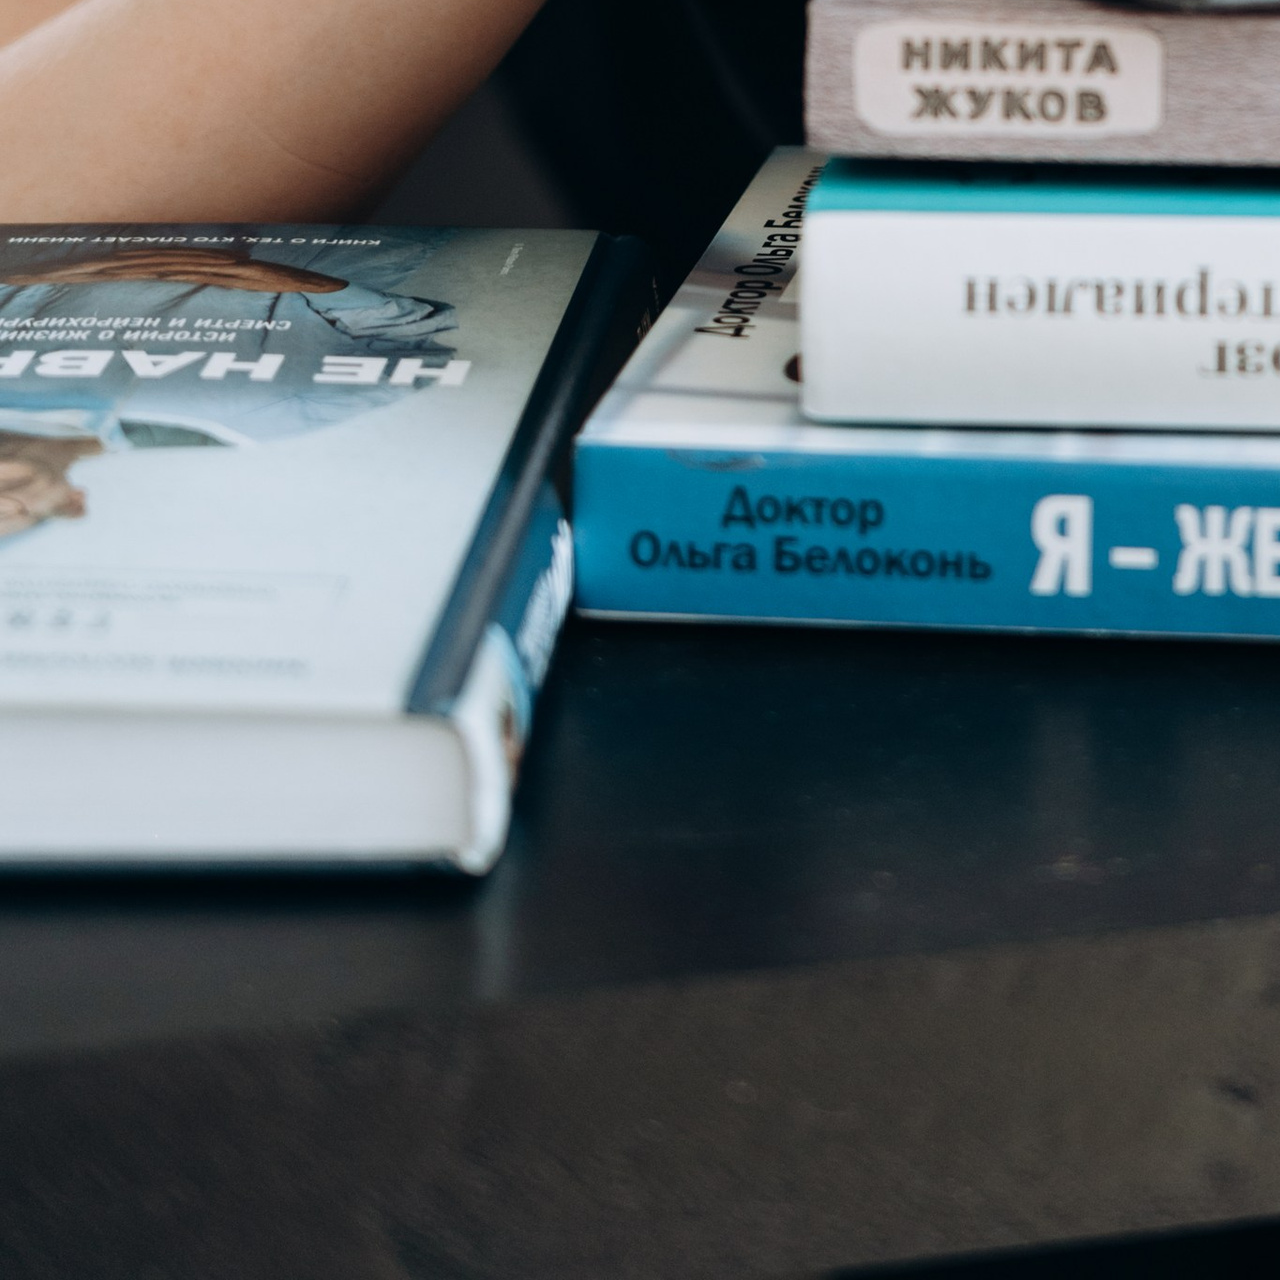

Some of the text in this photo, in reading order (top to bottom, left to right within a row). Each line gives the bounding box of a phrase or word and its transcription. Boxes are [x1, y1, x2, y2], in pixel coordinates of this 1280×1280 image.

[901, 37, 1119, 75] НИКИТА
[912, 87, 1108, 124] ЖУКОВ
[8, 235, 382, 247] КНИГИ О ТЕХ, КТО СПАСАЕТ ЖИЗНИ
[734, 233, 800, 276] Ольга
[168, 316, 188, 330] И
[193, 317, 292, 331] СМЕРТИ
[694, 280, 782, 338] Доктор
[97, 329, 116, 343] О
[124, 329, 237, 343] ИСТОРИИ
[313, 357, 473, 387] НЕ
[721, 484, 886, 537] Доктор
[629, 530, 994, 584] Ольга Белоконь
[1029, 494, 1094, 598] Я
